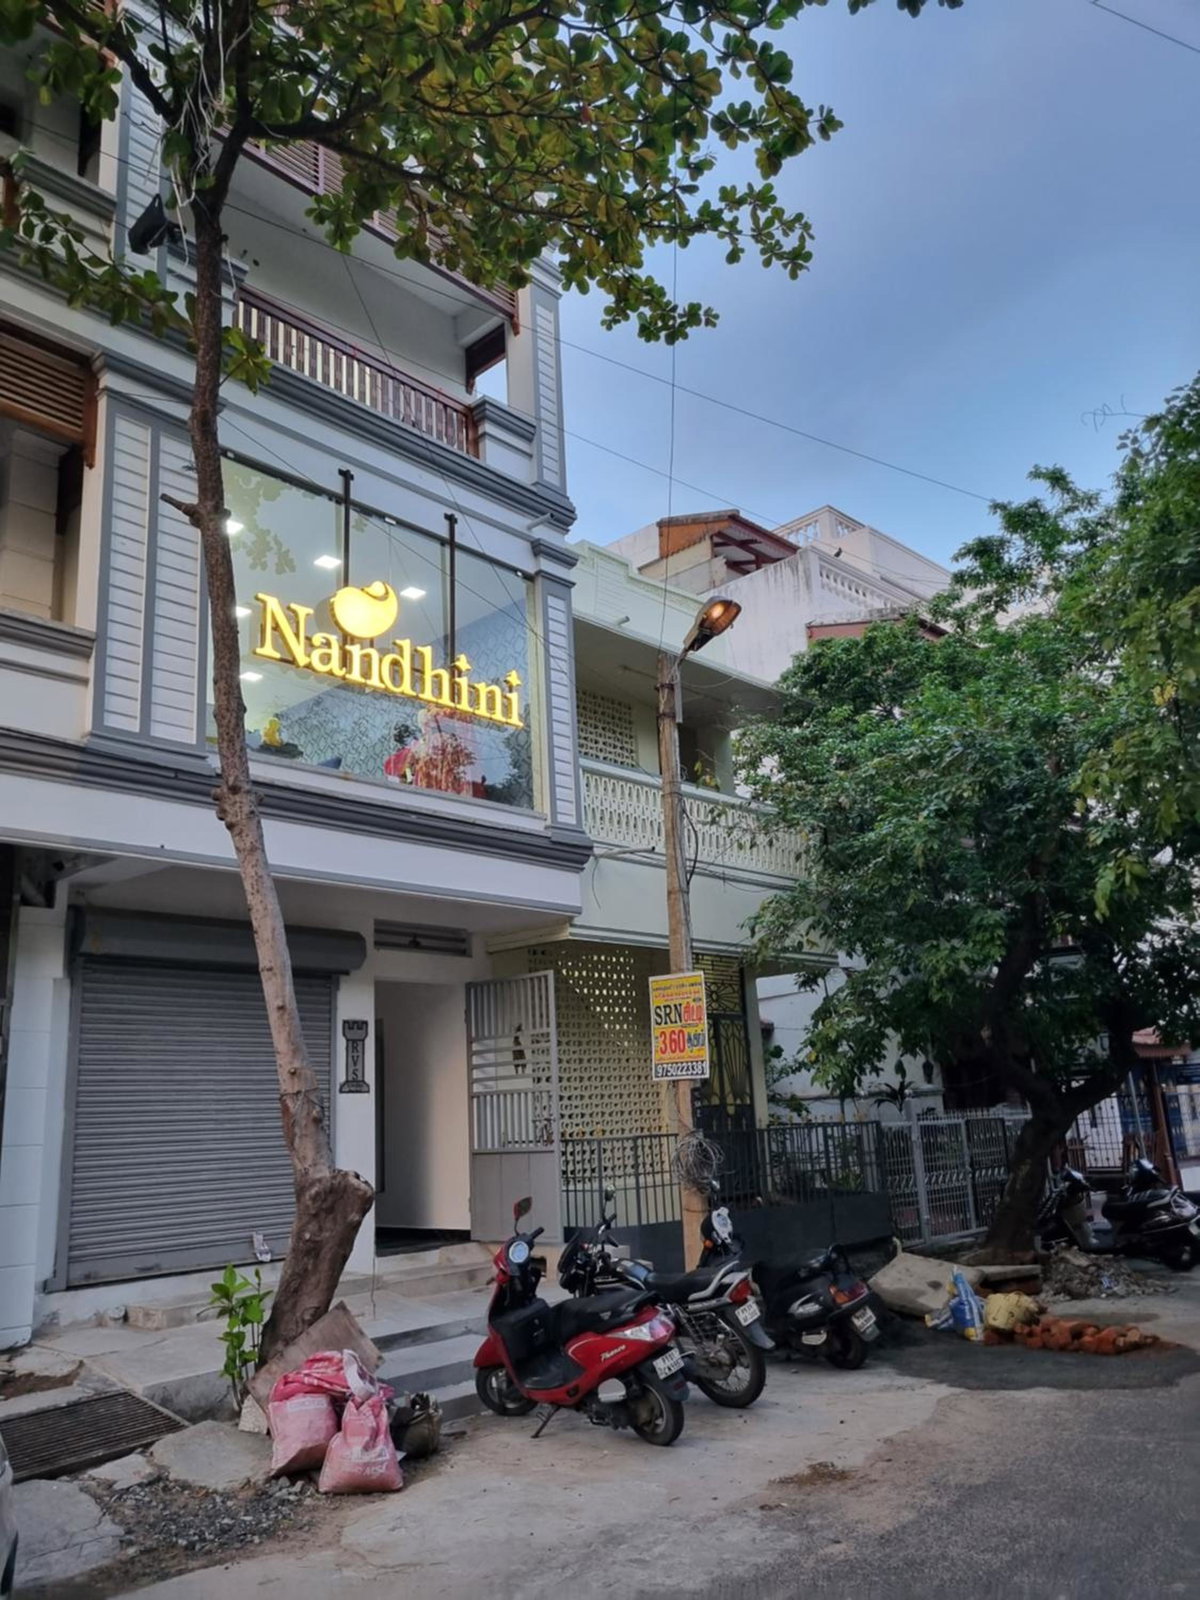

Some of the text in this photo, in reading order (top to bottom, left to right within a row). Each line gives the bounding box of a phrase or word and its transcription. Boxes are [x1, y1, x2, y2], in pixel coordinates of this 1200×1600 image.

[253, 593, 525, 729] Nandhini
[655, 1003, 682, 1026] SRN
[659, 1029, 686, 1054] 360
